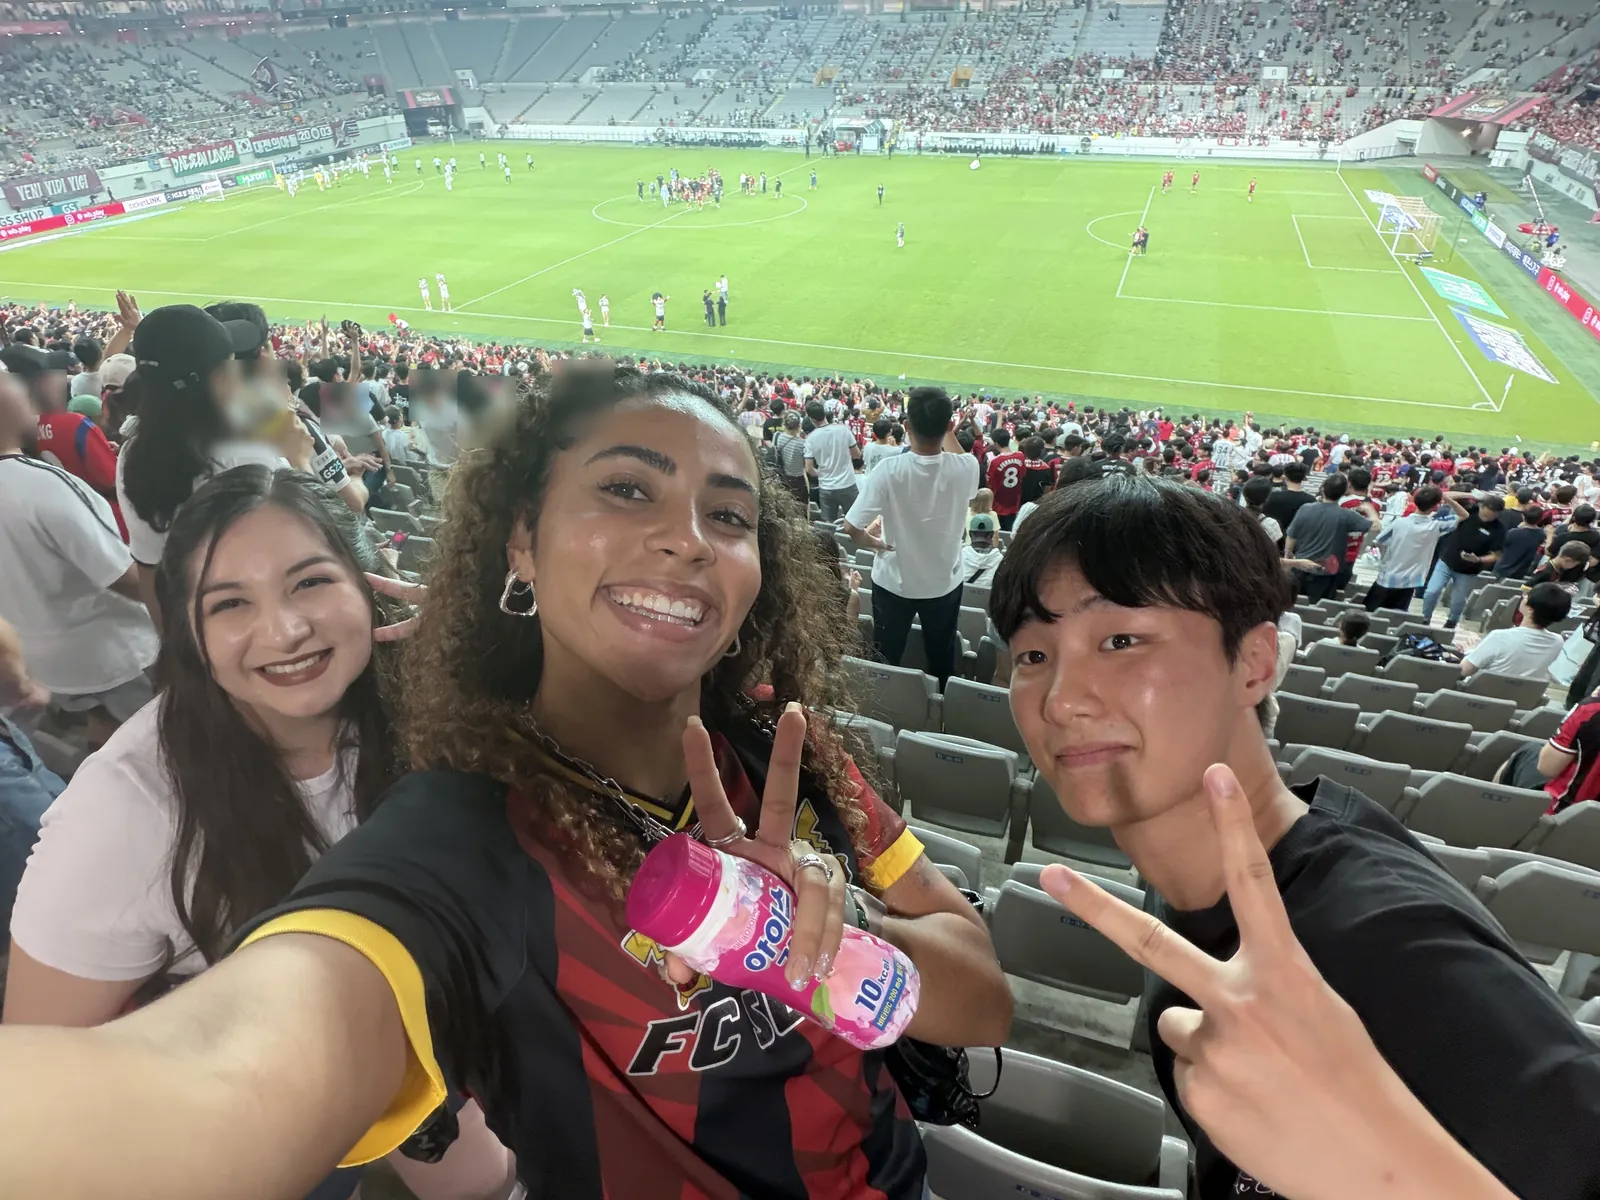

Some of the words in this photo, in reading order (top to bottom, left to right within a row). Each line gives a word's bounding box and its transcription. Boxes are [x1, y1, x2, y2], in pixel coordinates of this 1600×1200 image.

[300, 130, 311, 140] 20
[320, 126, 332, 137] 03
[0, 214, 14, 227] GS
[13, 210, 44, 223] SHOP
[62, 203, 77, 214] GS
[323, 460, 343, 480] GS25
[1003, 466, 1019, 488] 8
[854, 977, 882, 1012] 10
[877, 958, 890, 985] kcal
[625, 996, 741, 1076] FC
